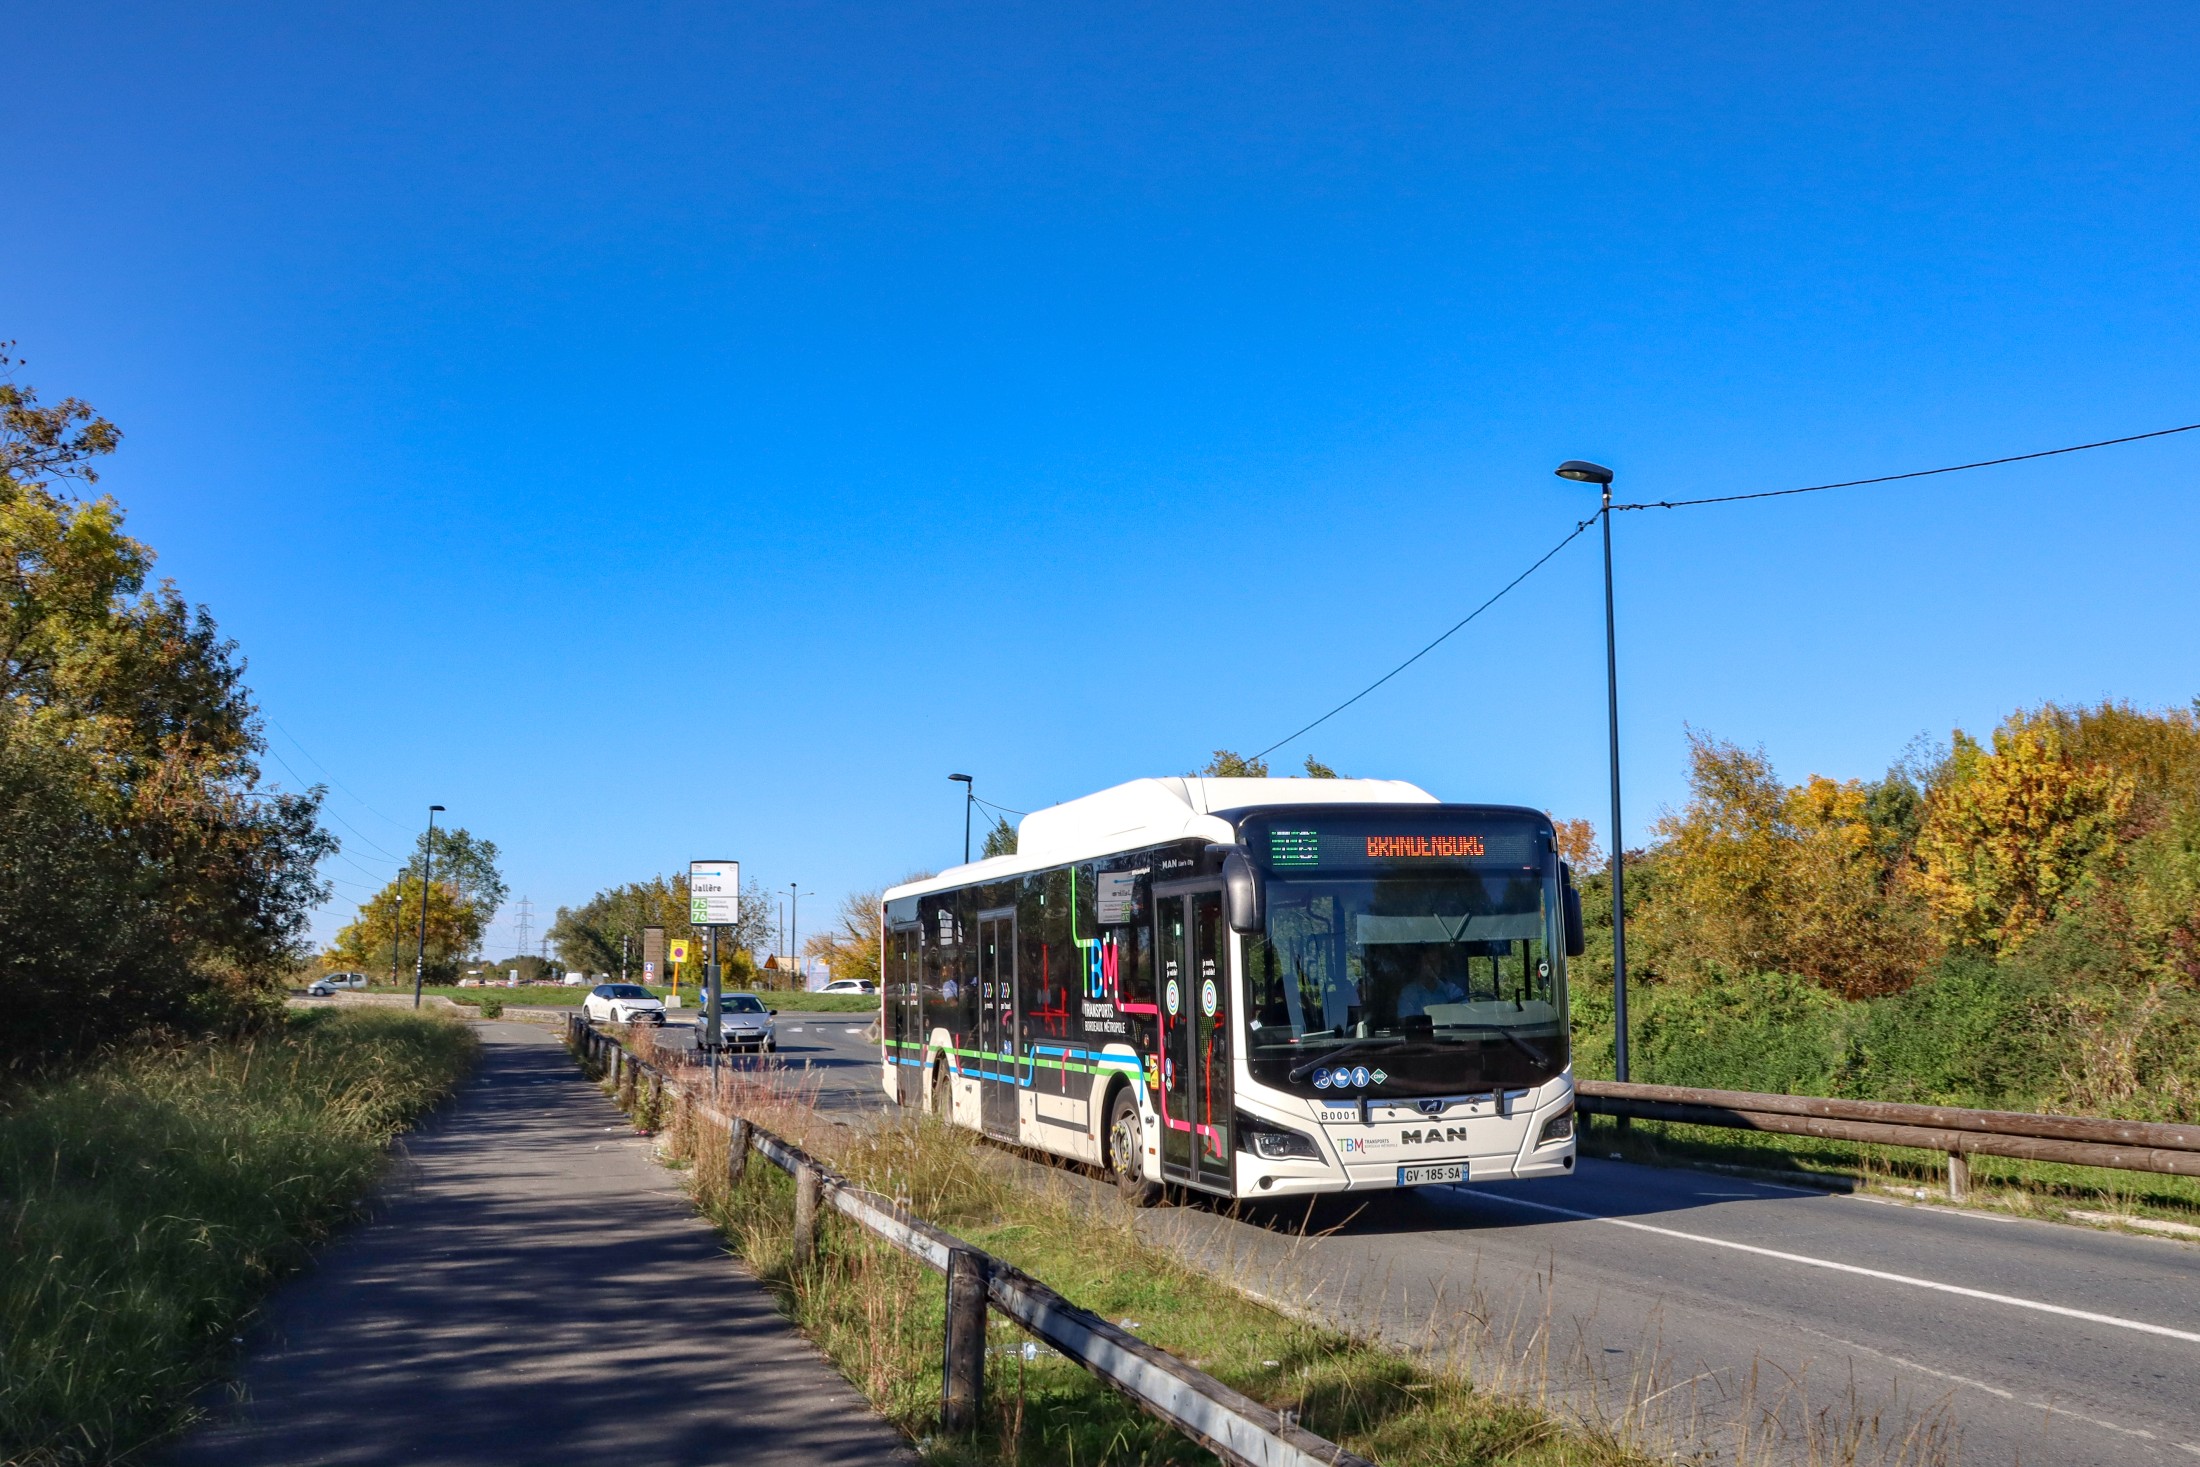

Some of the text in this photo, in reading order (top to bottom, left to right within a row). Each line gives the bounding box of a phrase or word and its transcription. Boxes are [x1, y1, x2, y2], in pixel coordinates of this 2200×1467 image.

[1367, 836, 1484, 857] BRANDENBURG
[1162, 859, 1177, 869] MAN
[692, 883, 722, 892] Jallère
[693, 899, 707, 908] 75
[693, 912, 707, 921] 76
[1076, 936, 1119, 999] TBM
[1084, 1003, 1114, 1018] TRANSPORTS
[1084, 1020, 1104, 1032] BORDEAUX
[1321, 1110, 1356, 1121] B0001
[1401, 1127, 1467, 1144] MAN
[1337, 1138, 1366, 1154] TBM
